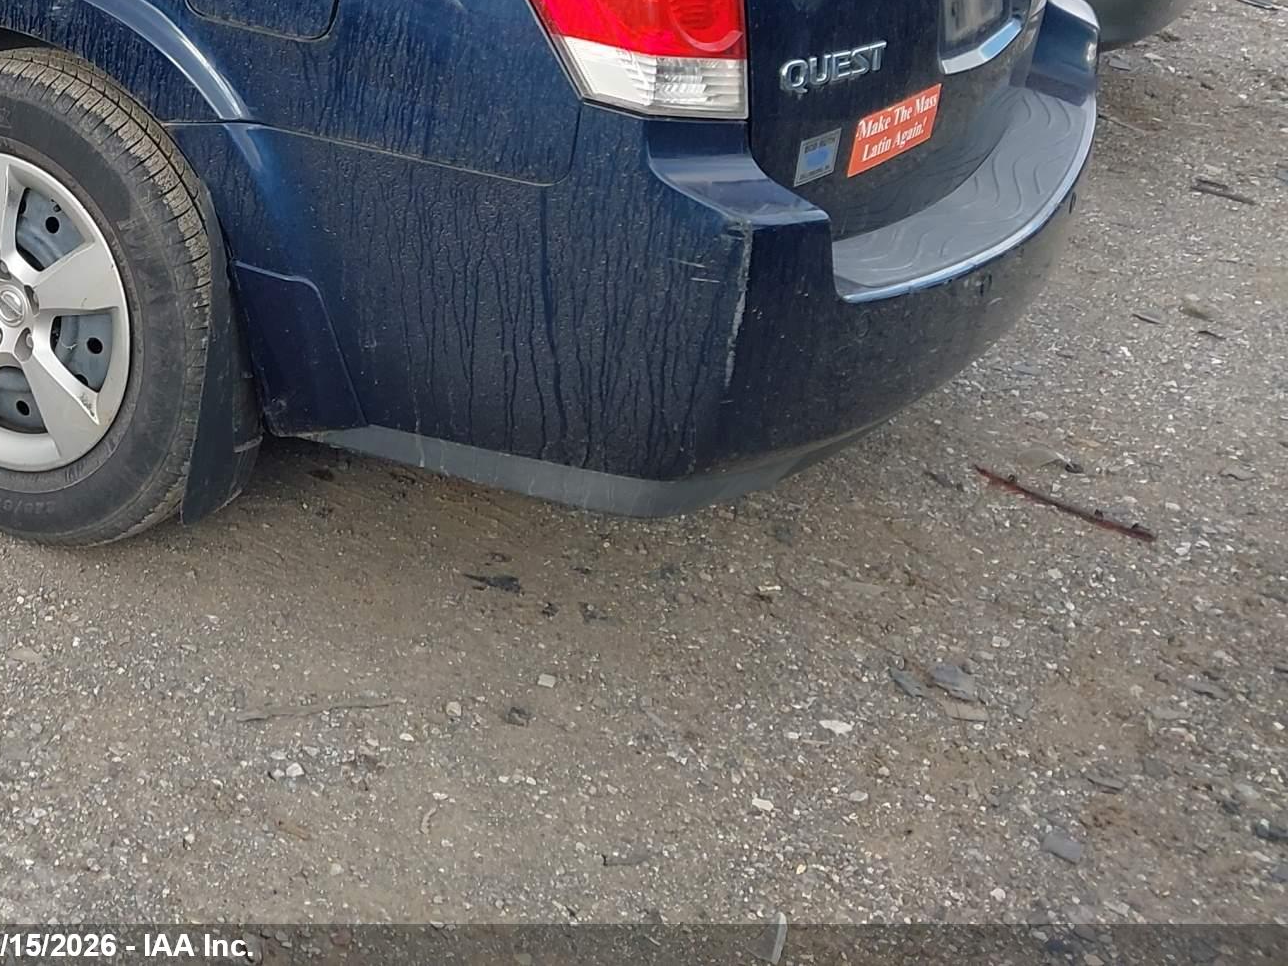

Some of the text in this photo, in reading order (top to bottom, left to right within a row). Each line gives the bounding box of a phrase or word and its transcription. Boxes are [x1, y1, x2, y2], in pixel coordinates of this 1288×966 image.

[780, 41, 887, 94] QUEST
[856, 117, 892, 141] Make
[894, 105, 913, 125] The
[861, 136, 892, 162] Latin
[892, 116, 928, 148] Again!
